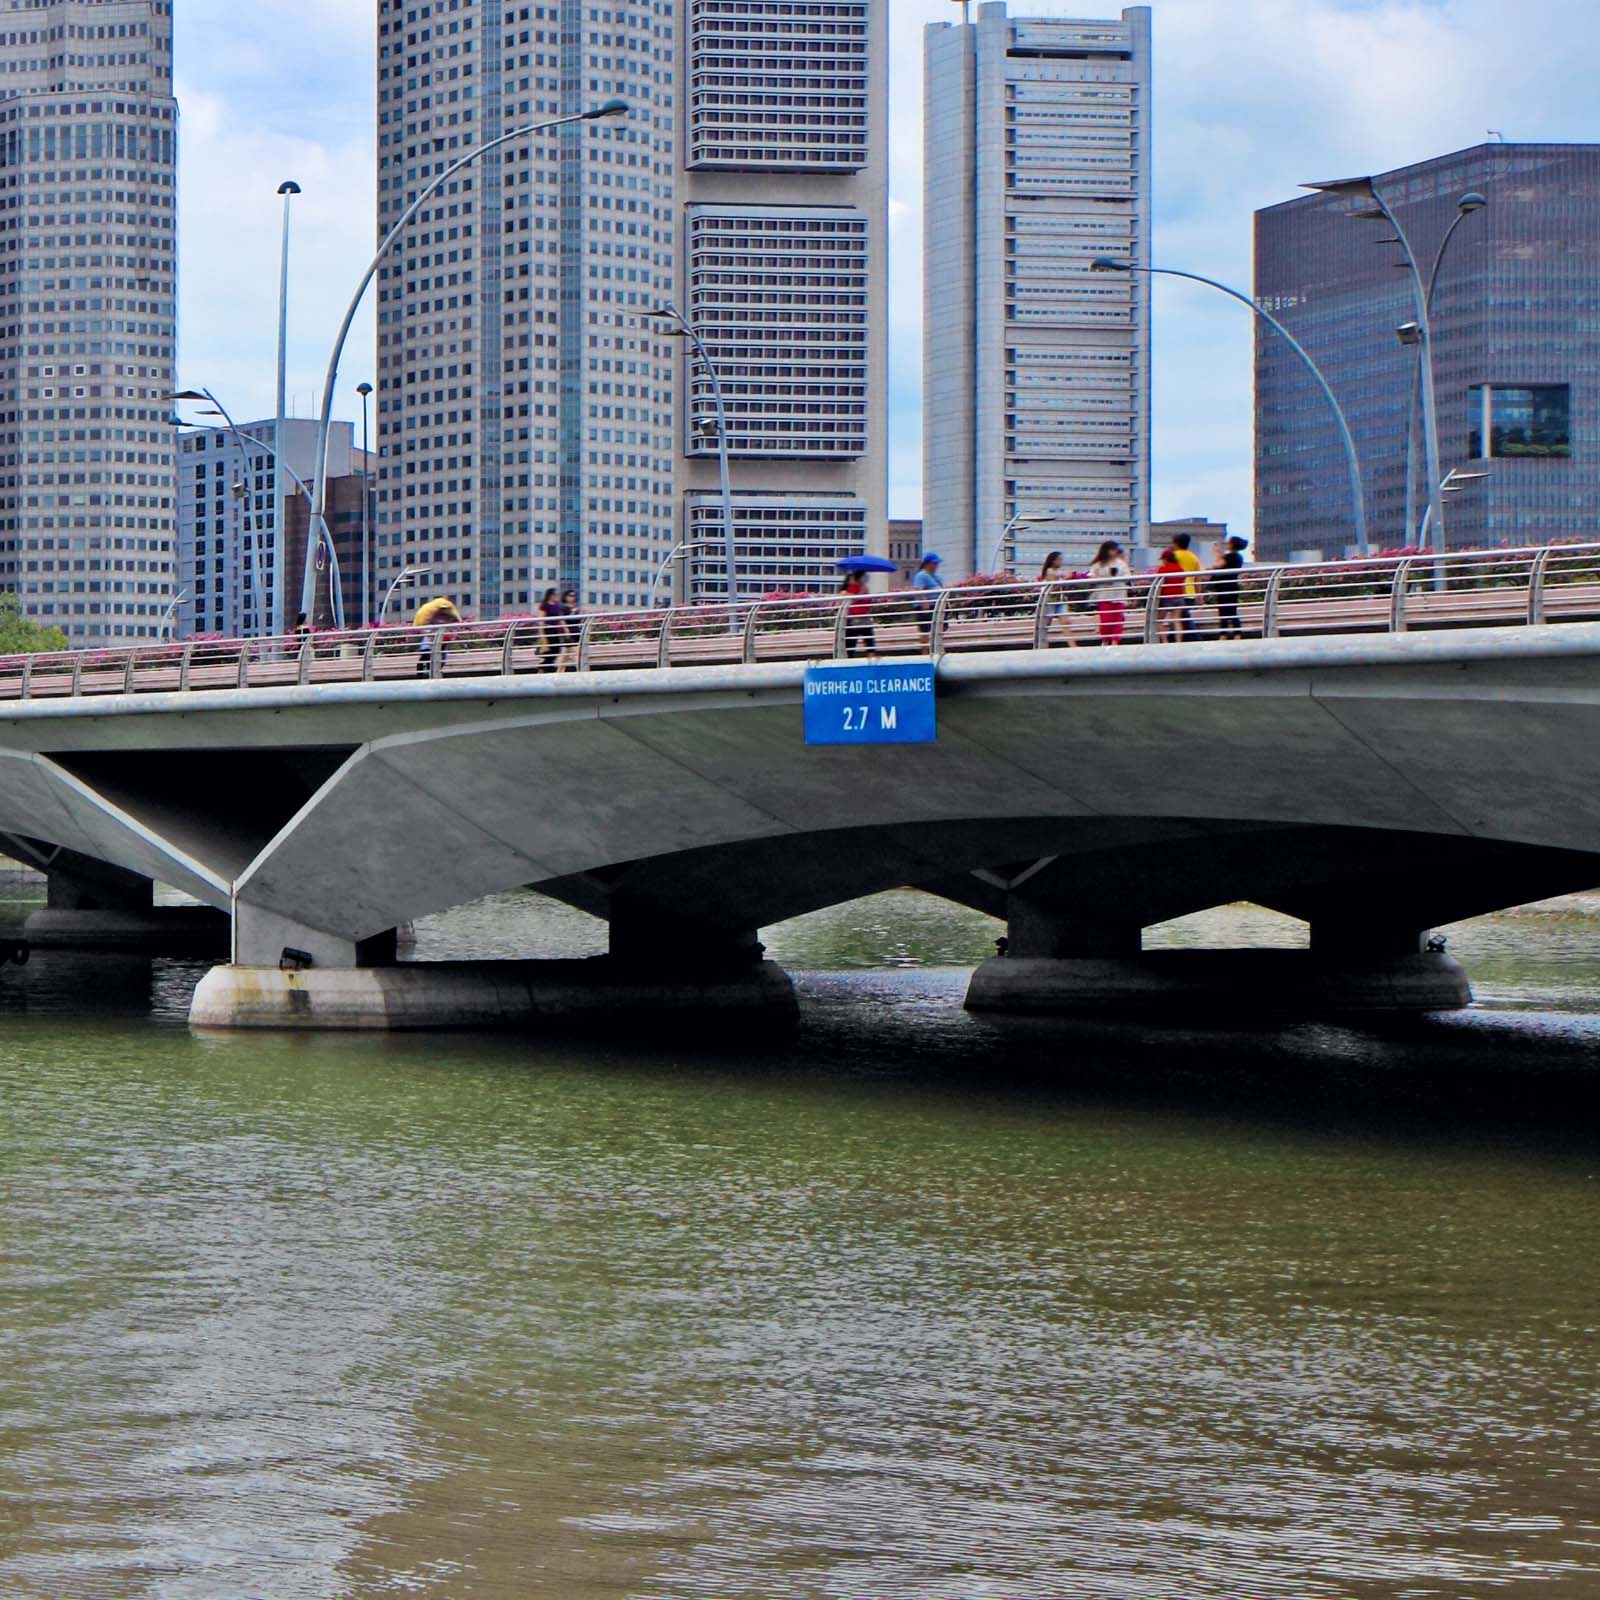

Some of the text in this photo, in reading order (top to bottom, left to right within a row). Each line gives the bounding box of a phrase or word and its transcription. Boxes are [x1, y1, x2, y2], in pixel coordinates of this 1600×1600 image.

[807, 677, 932, 696] OVERHEAD CLEARANCE
[842, 705, 897, 730] 2.7 M
